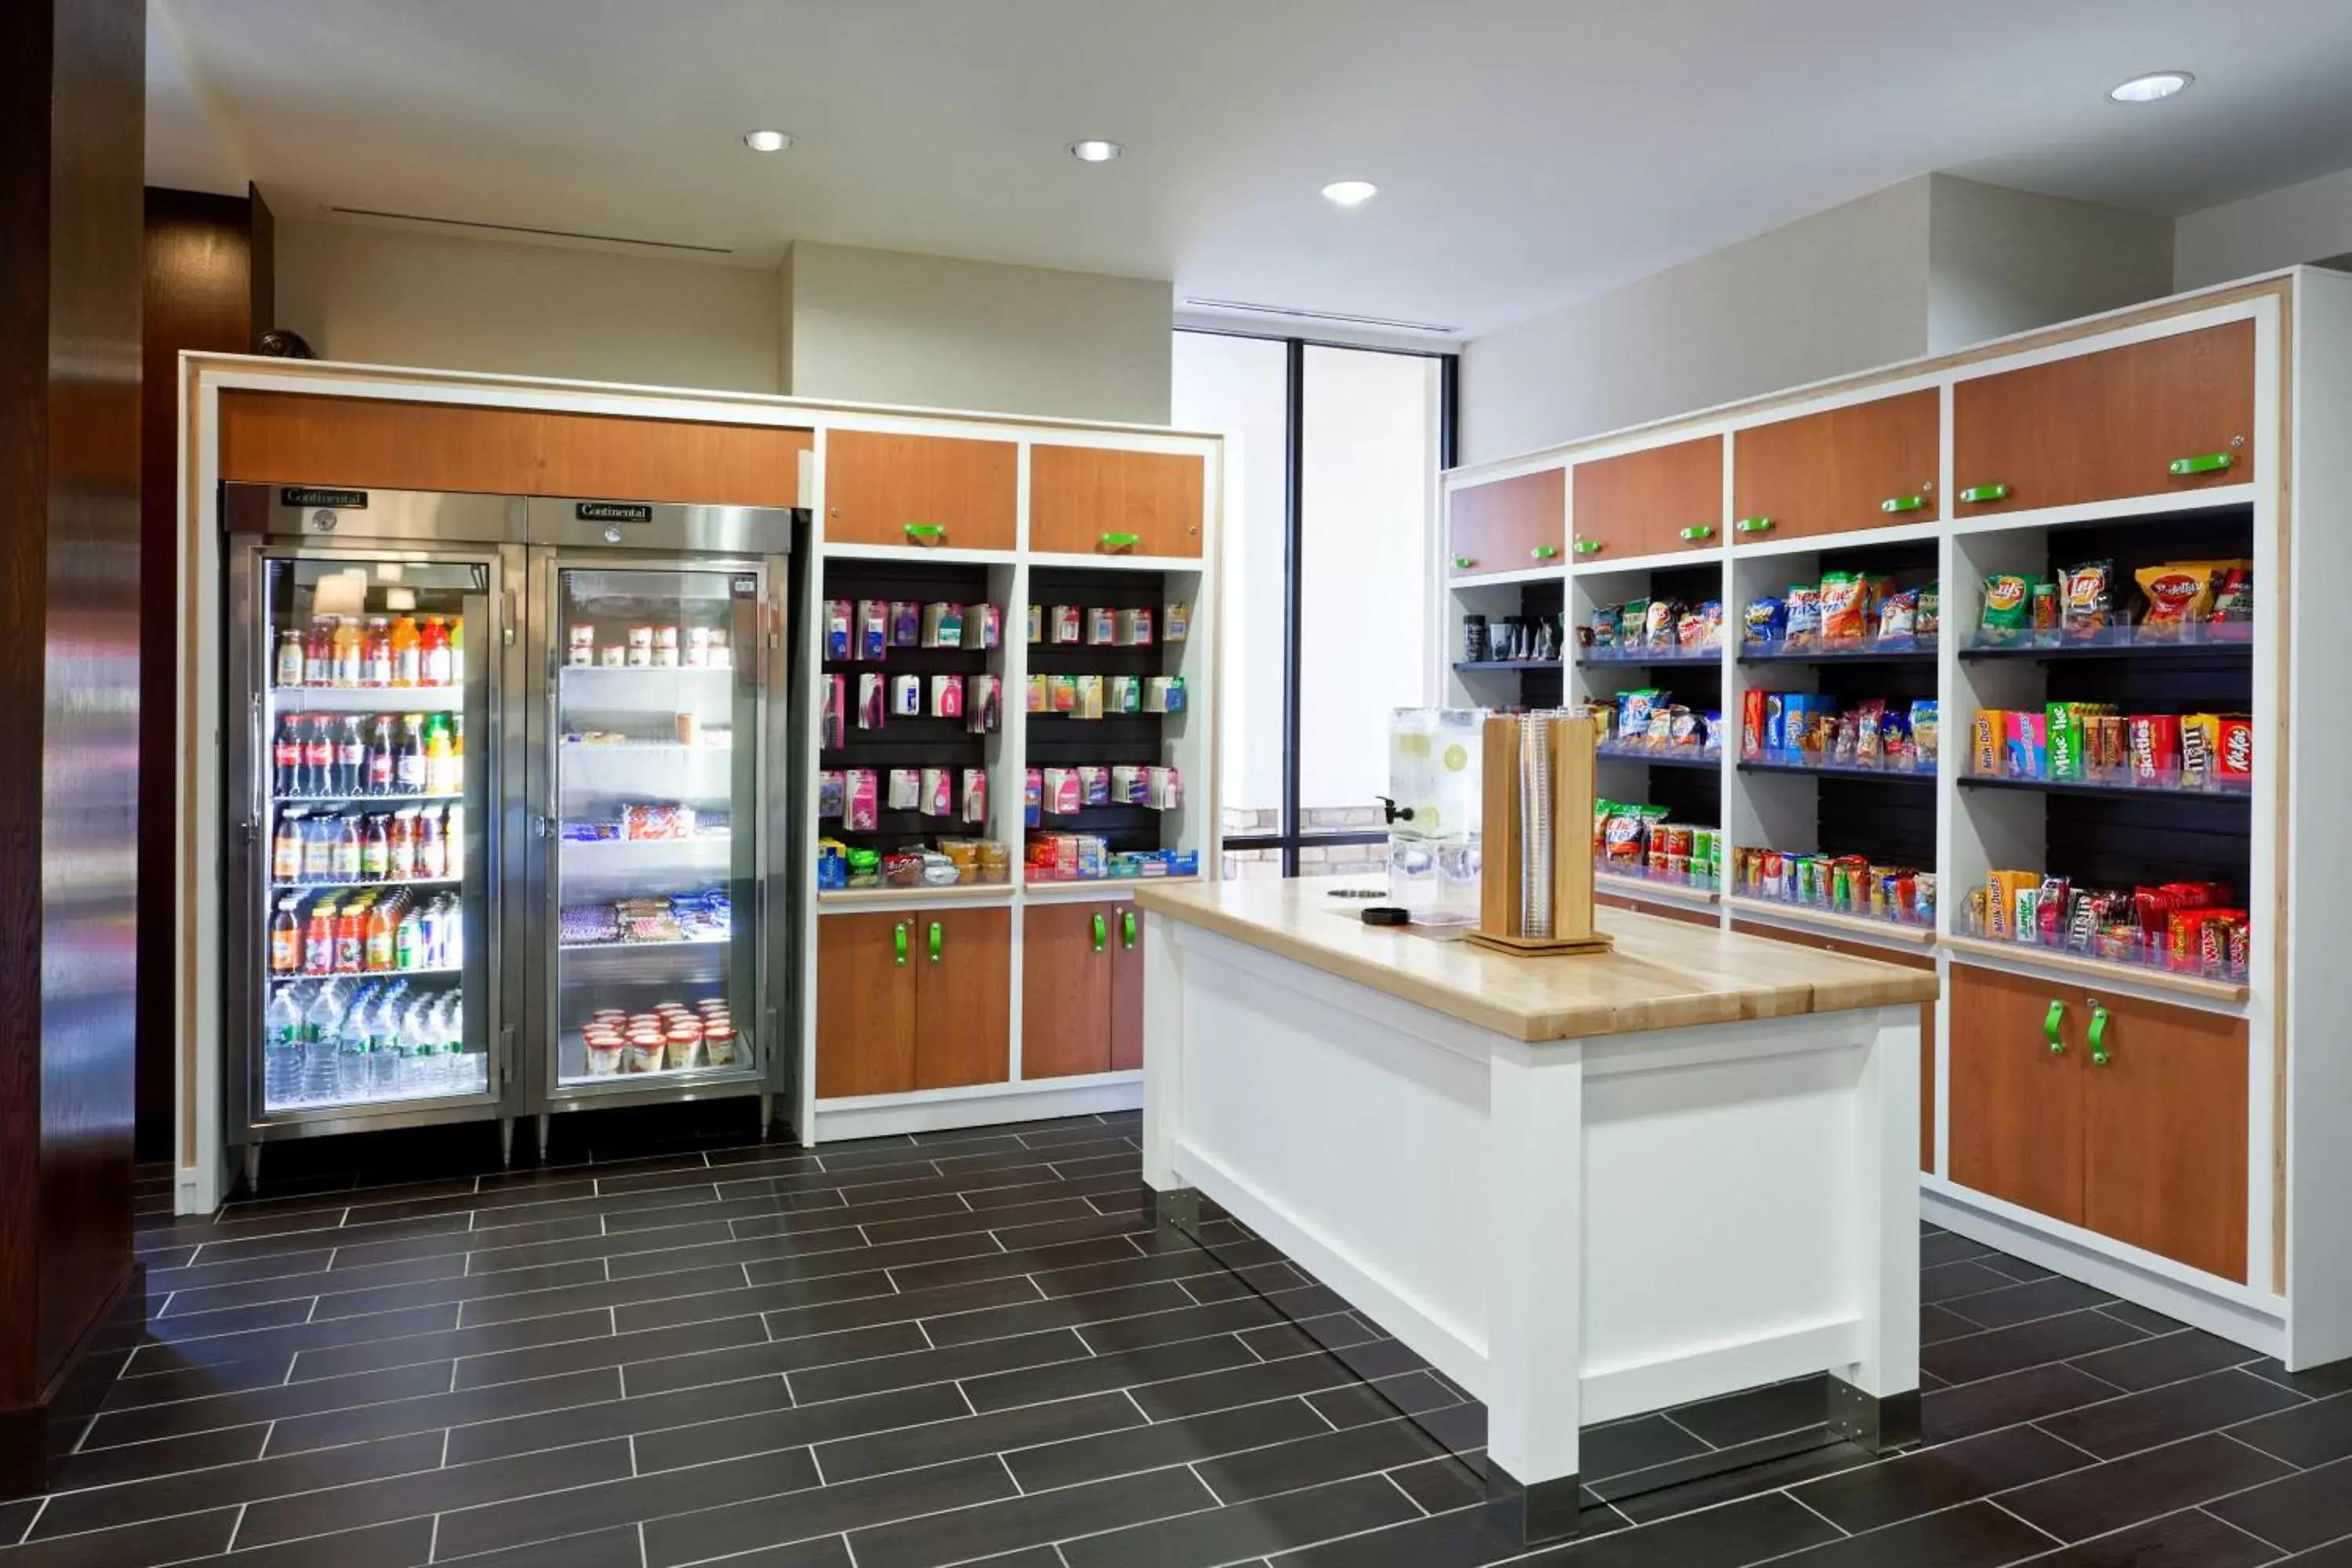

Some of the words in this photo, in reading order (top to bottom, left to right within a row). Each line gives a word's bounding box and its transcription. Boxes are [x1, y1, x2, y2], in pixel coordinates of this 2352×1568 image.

[287, 488, 360, 503] Continental
[582, 504, 645, 517] Continental
[2053, 706, 2067, 729] Ike
[2054, 735, 2071, 775] Mike
[2135, 719, 2155, 779] Skittles
[1990, 876, 2001, 906] Duds
[1994, 909, 2005, 934] Milk
